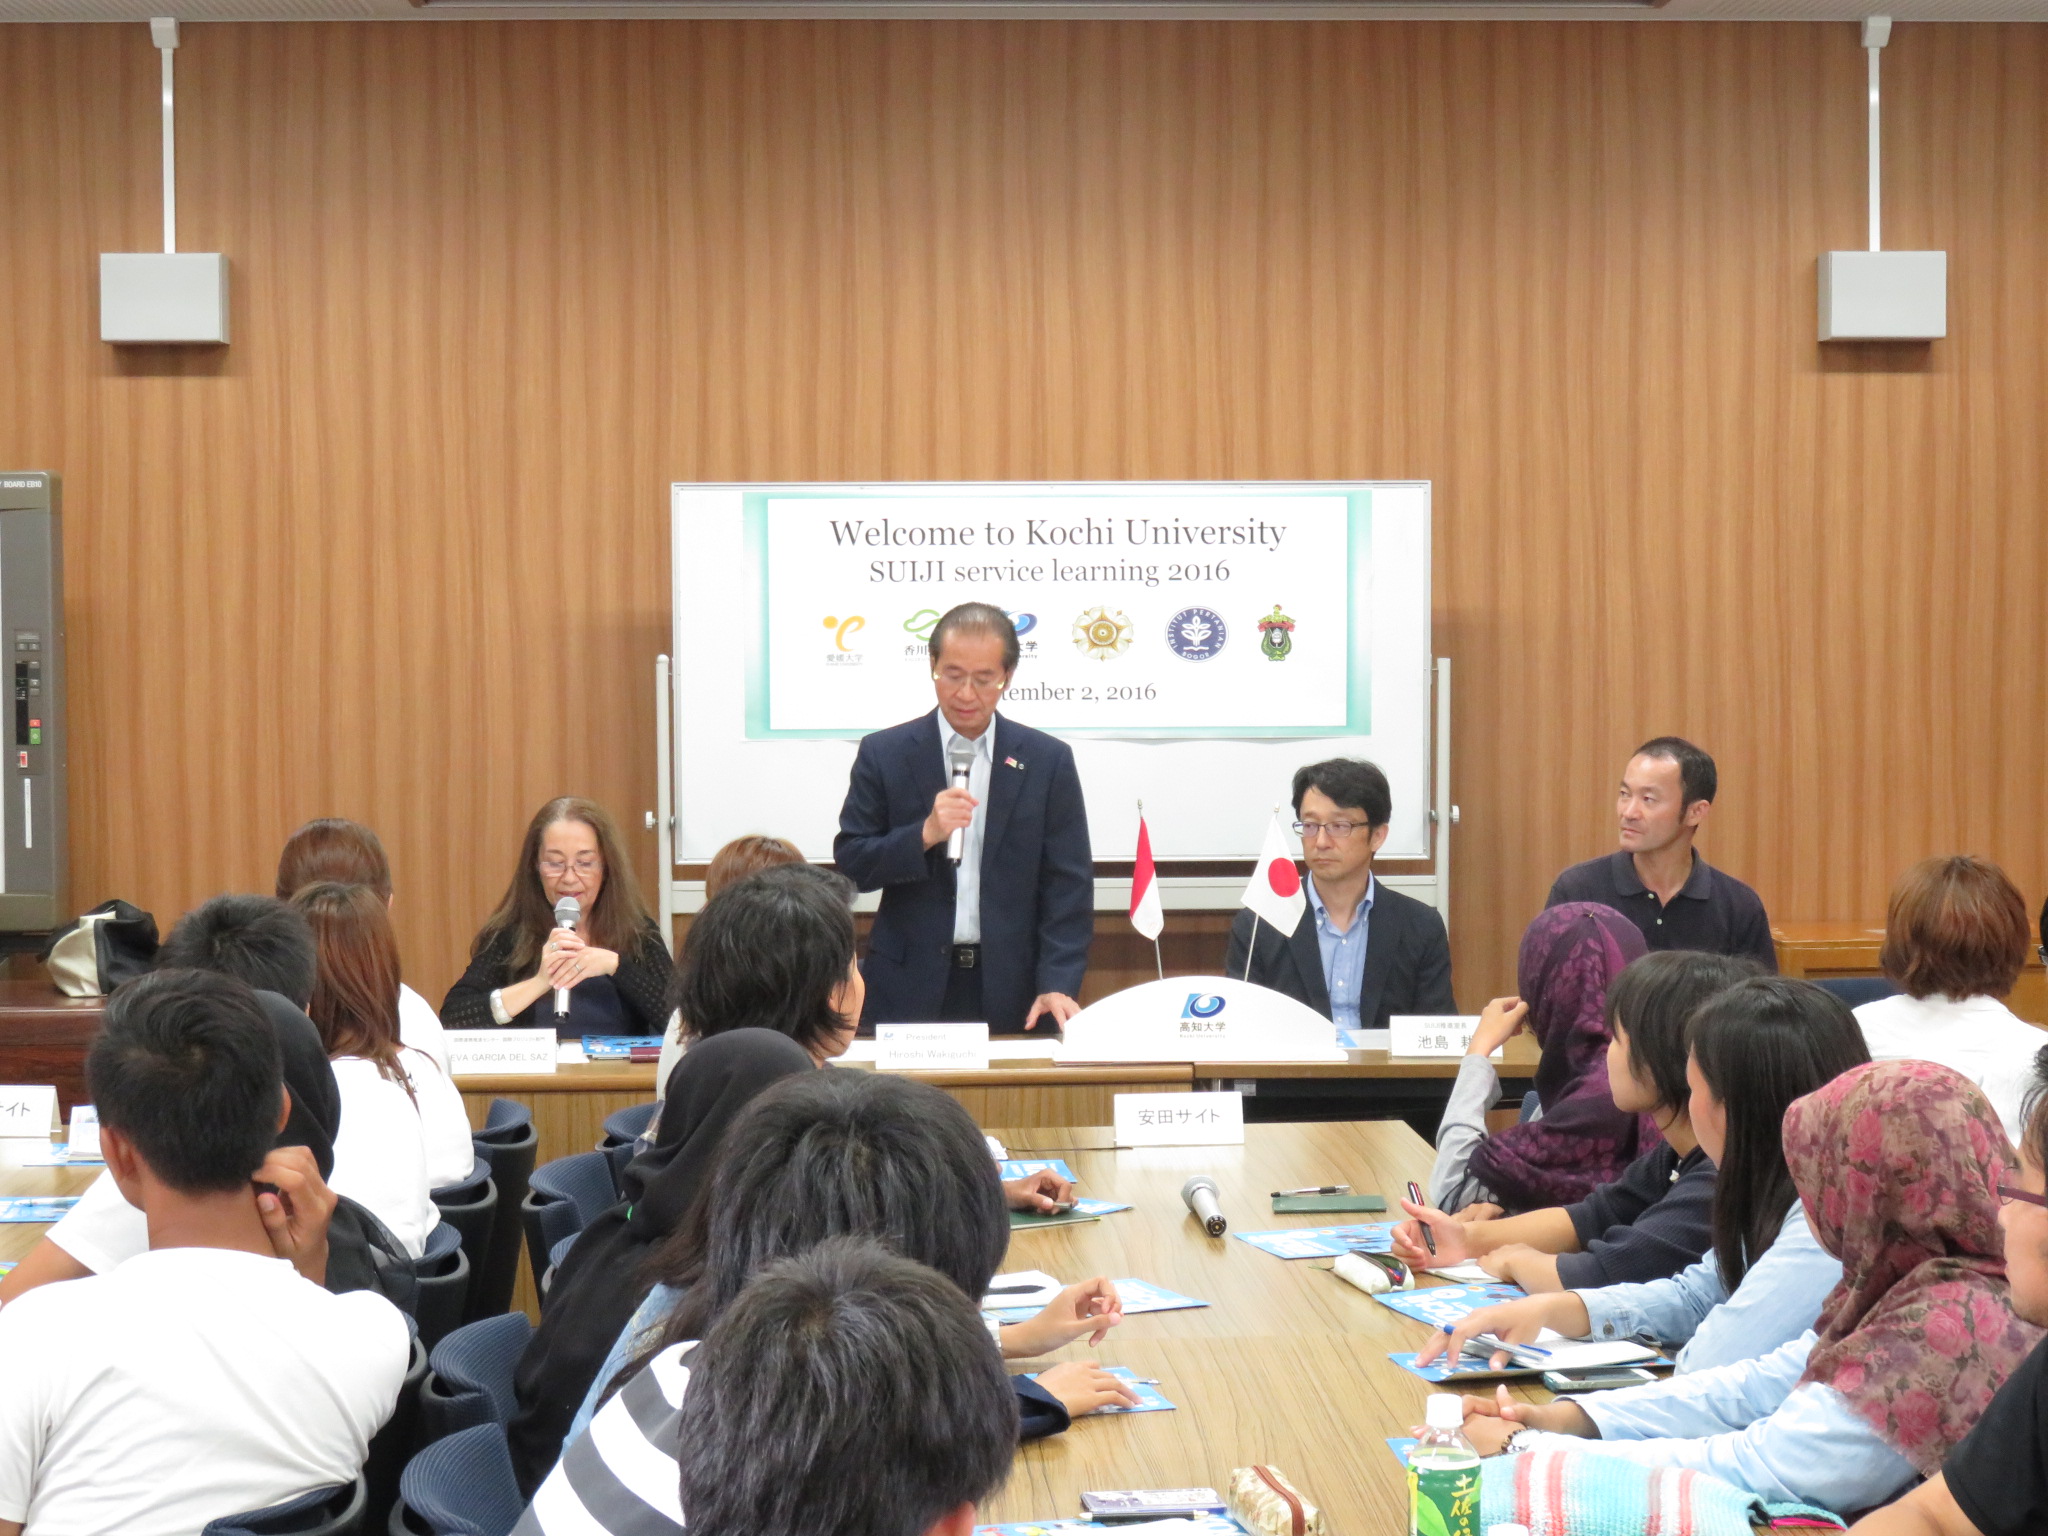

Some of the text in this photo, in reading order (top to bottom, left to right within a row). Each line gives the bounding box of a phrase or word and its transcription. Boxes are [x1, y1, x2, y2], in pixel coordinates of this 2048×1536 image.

[4, 480, 26, 488] BOARD
[829, 518, 1287, 552] Welcome to Kochi University
[869, 558, 1230, 588] SUIJI service learning 2016
[1001, 681, 1157, 704] tember 2, 2016
[1180, 1021, 1226, 1032] 高知大学
[906, 1033, 946, 1041] President
[1417, 1035, 1449, 1050] 池島
[450, 1052, 549, 1062] EVA GARCIA DEL SAZ
[889, 1050, 977, 1060] Hiroshi Wakiguchi
[1138, 1109, 1220, 1126] 安田サイト
